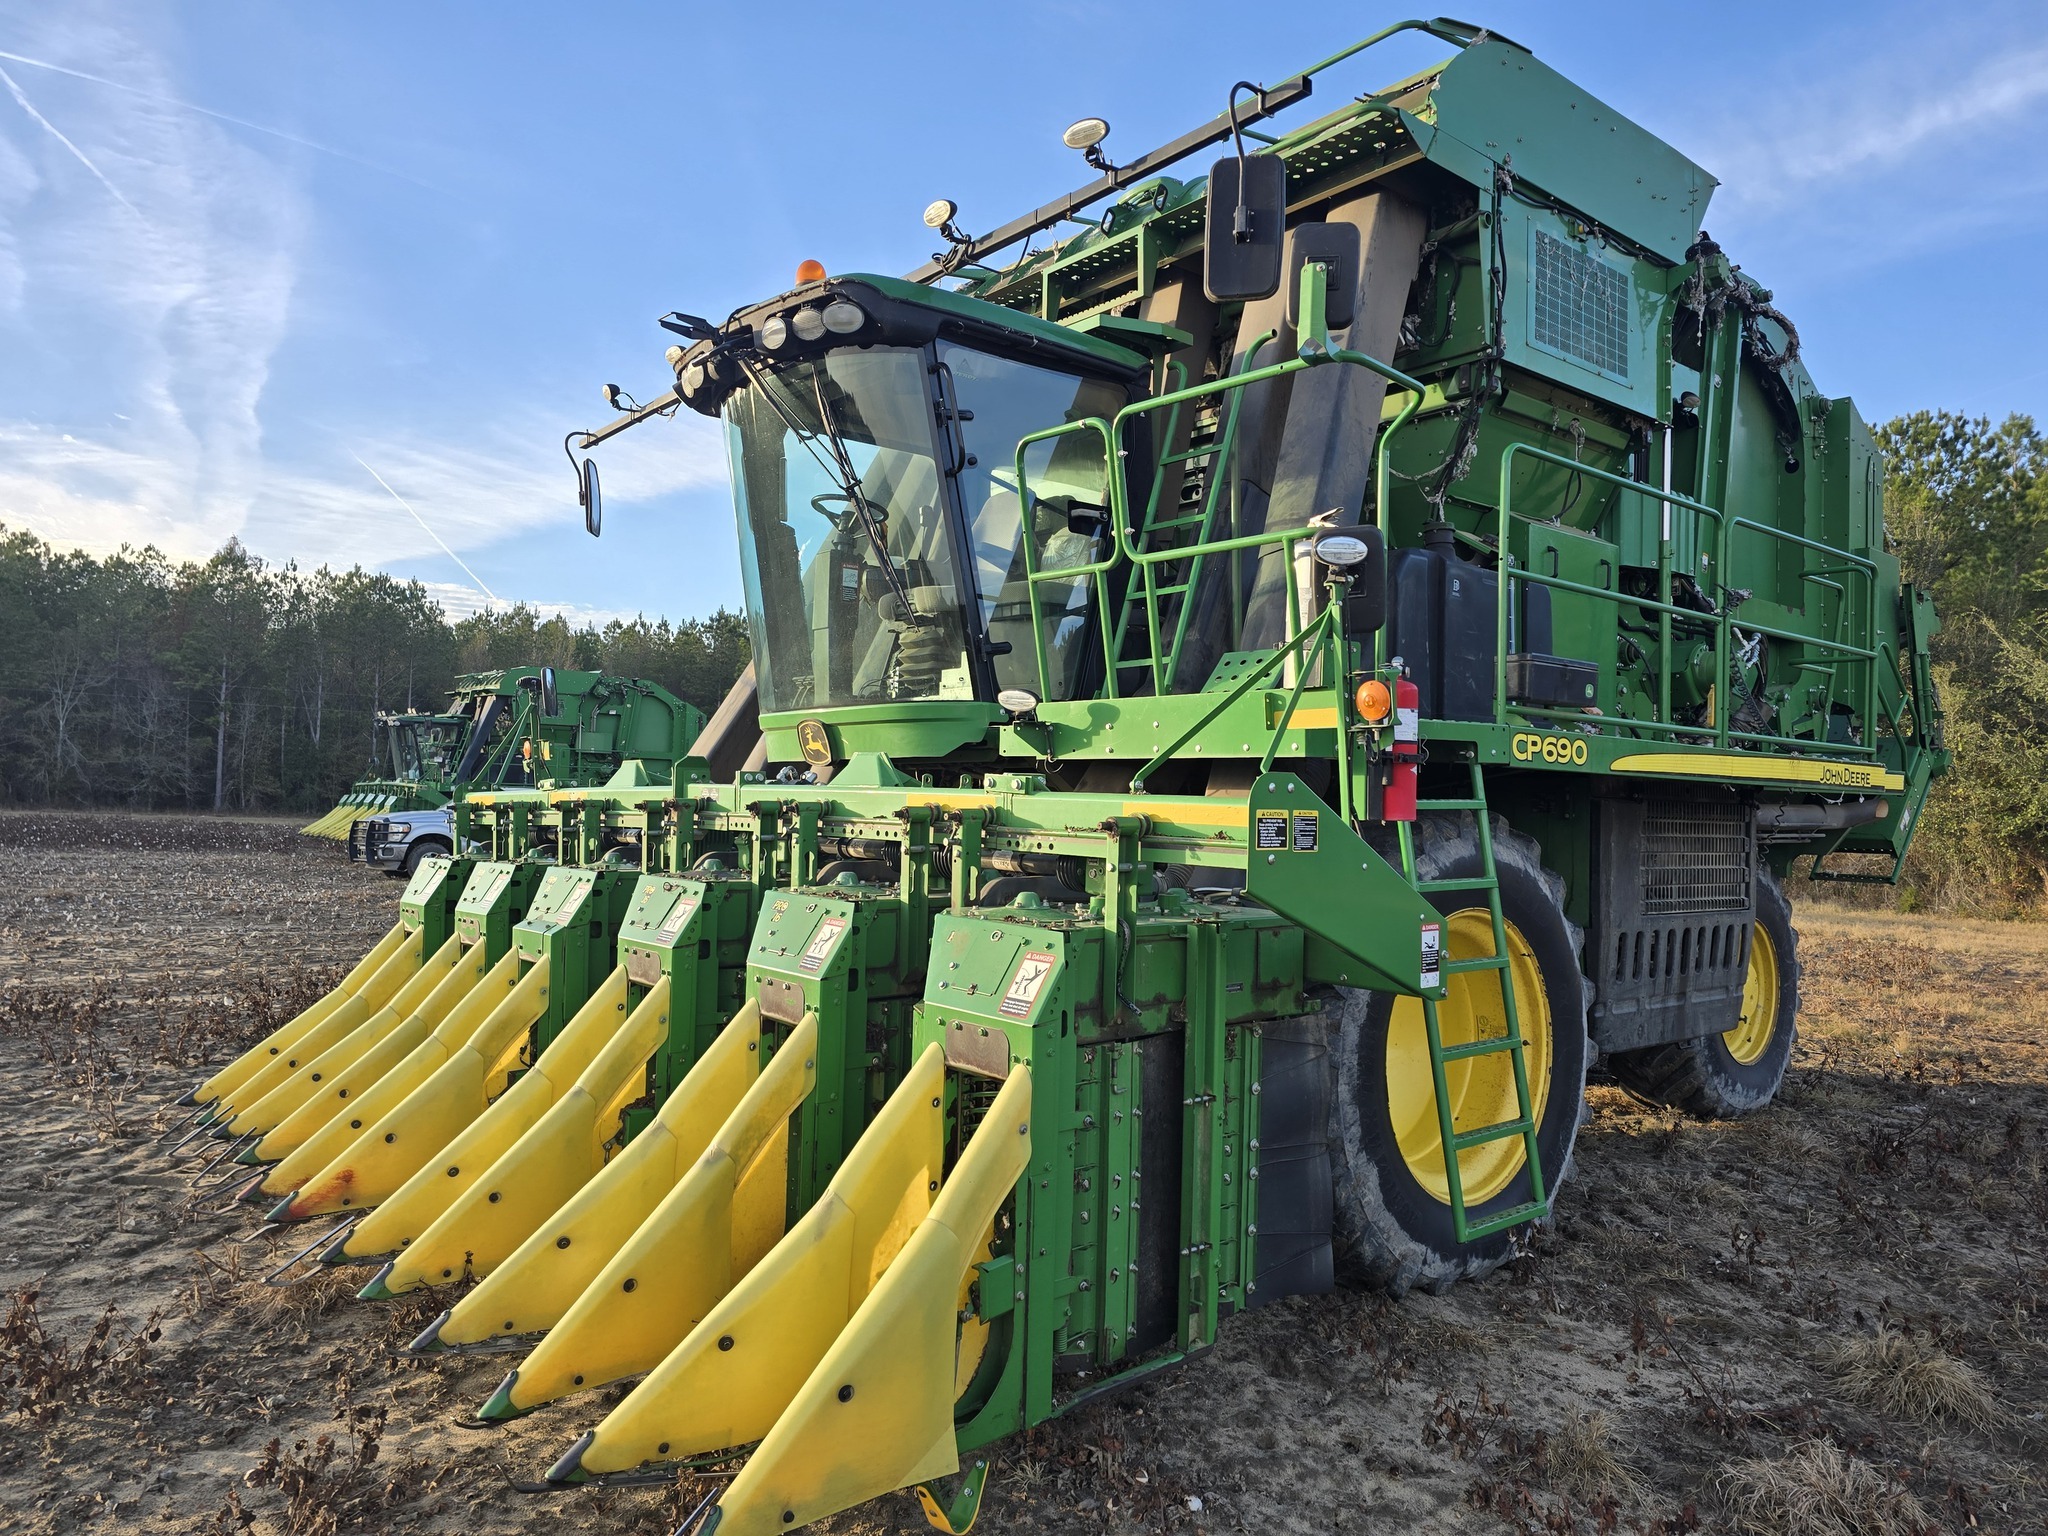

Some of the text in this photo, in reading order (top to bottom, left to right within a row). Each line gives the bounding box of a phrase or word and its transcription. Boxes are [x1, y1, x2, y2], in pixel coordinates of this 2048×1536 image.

[1512, 732, 1588, 766] CP690
[1820, 766, 1871, 785] JOHN DEERE
[1031, 953, 1055, 963] DANGER
